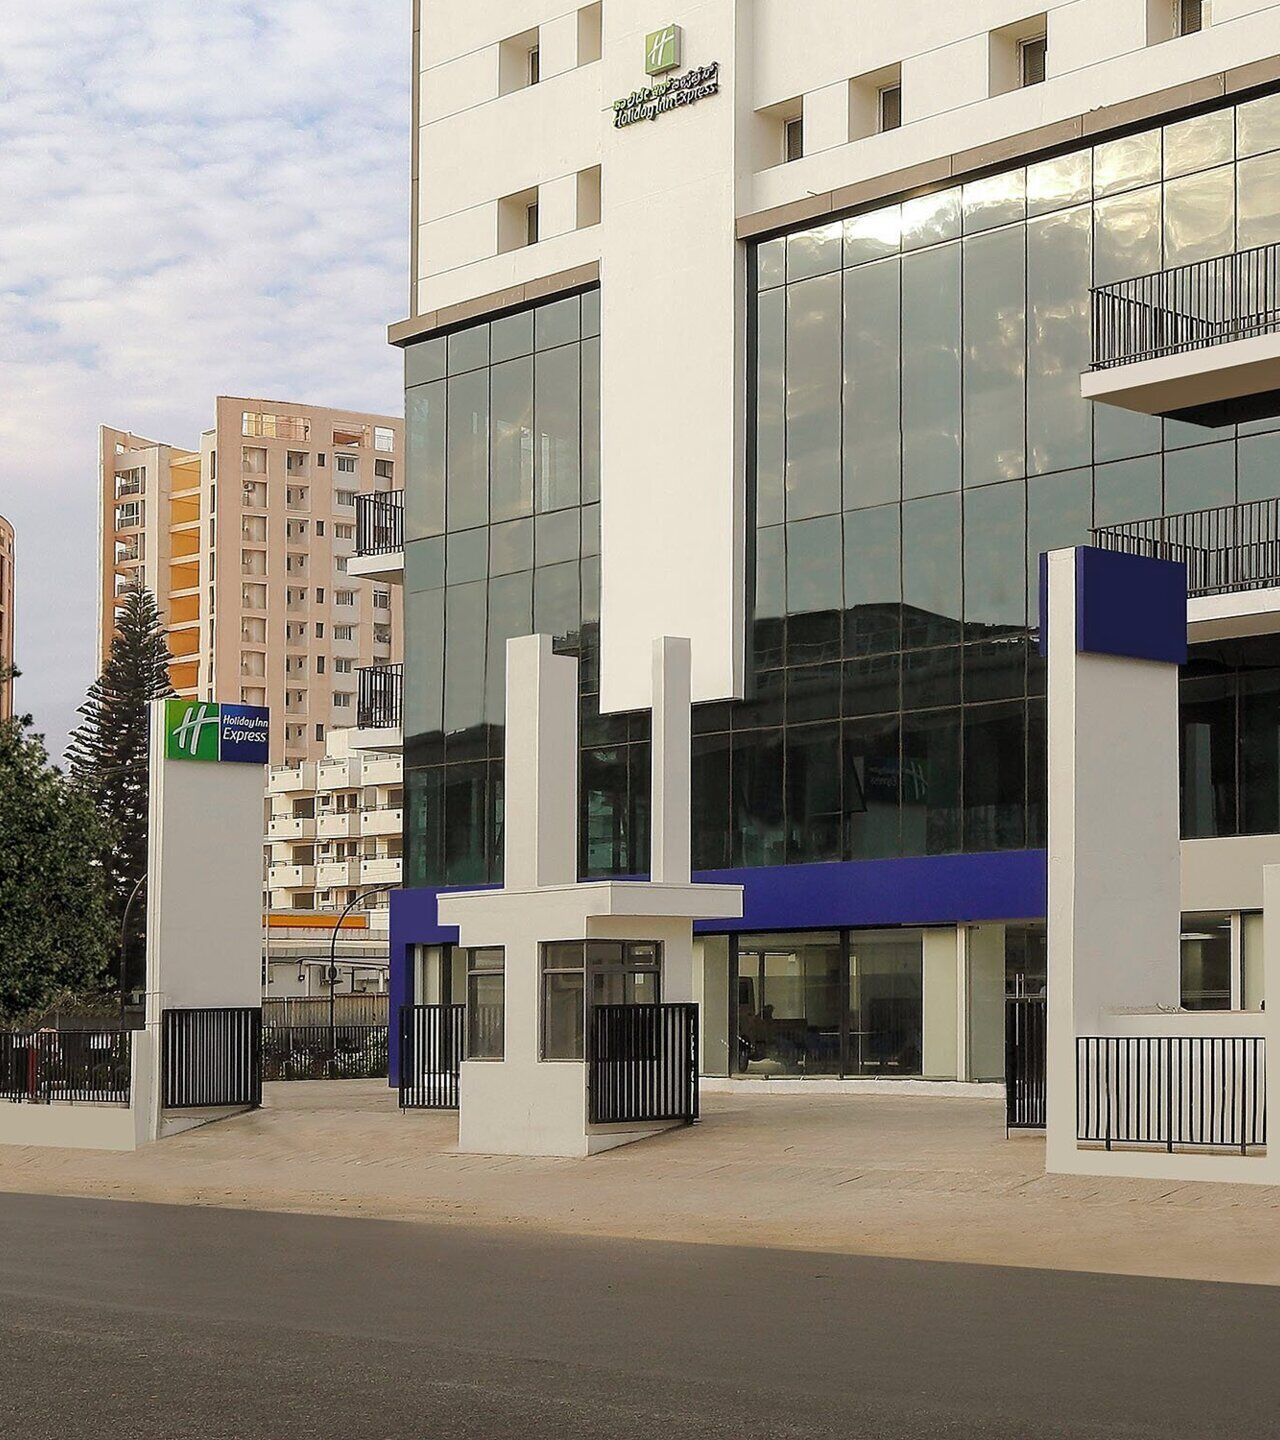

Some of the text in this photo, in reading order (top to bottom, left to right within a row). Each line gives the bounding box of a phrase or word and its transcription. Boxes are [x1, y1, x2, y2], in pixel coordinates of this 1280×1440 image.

[613, 83, 718, 128] Holiday Inn Express
[223, 714, 268, 728] Holiday Inn
[223, 726, 267, 743] Express
